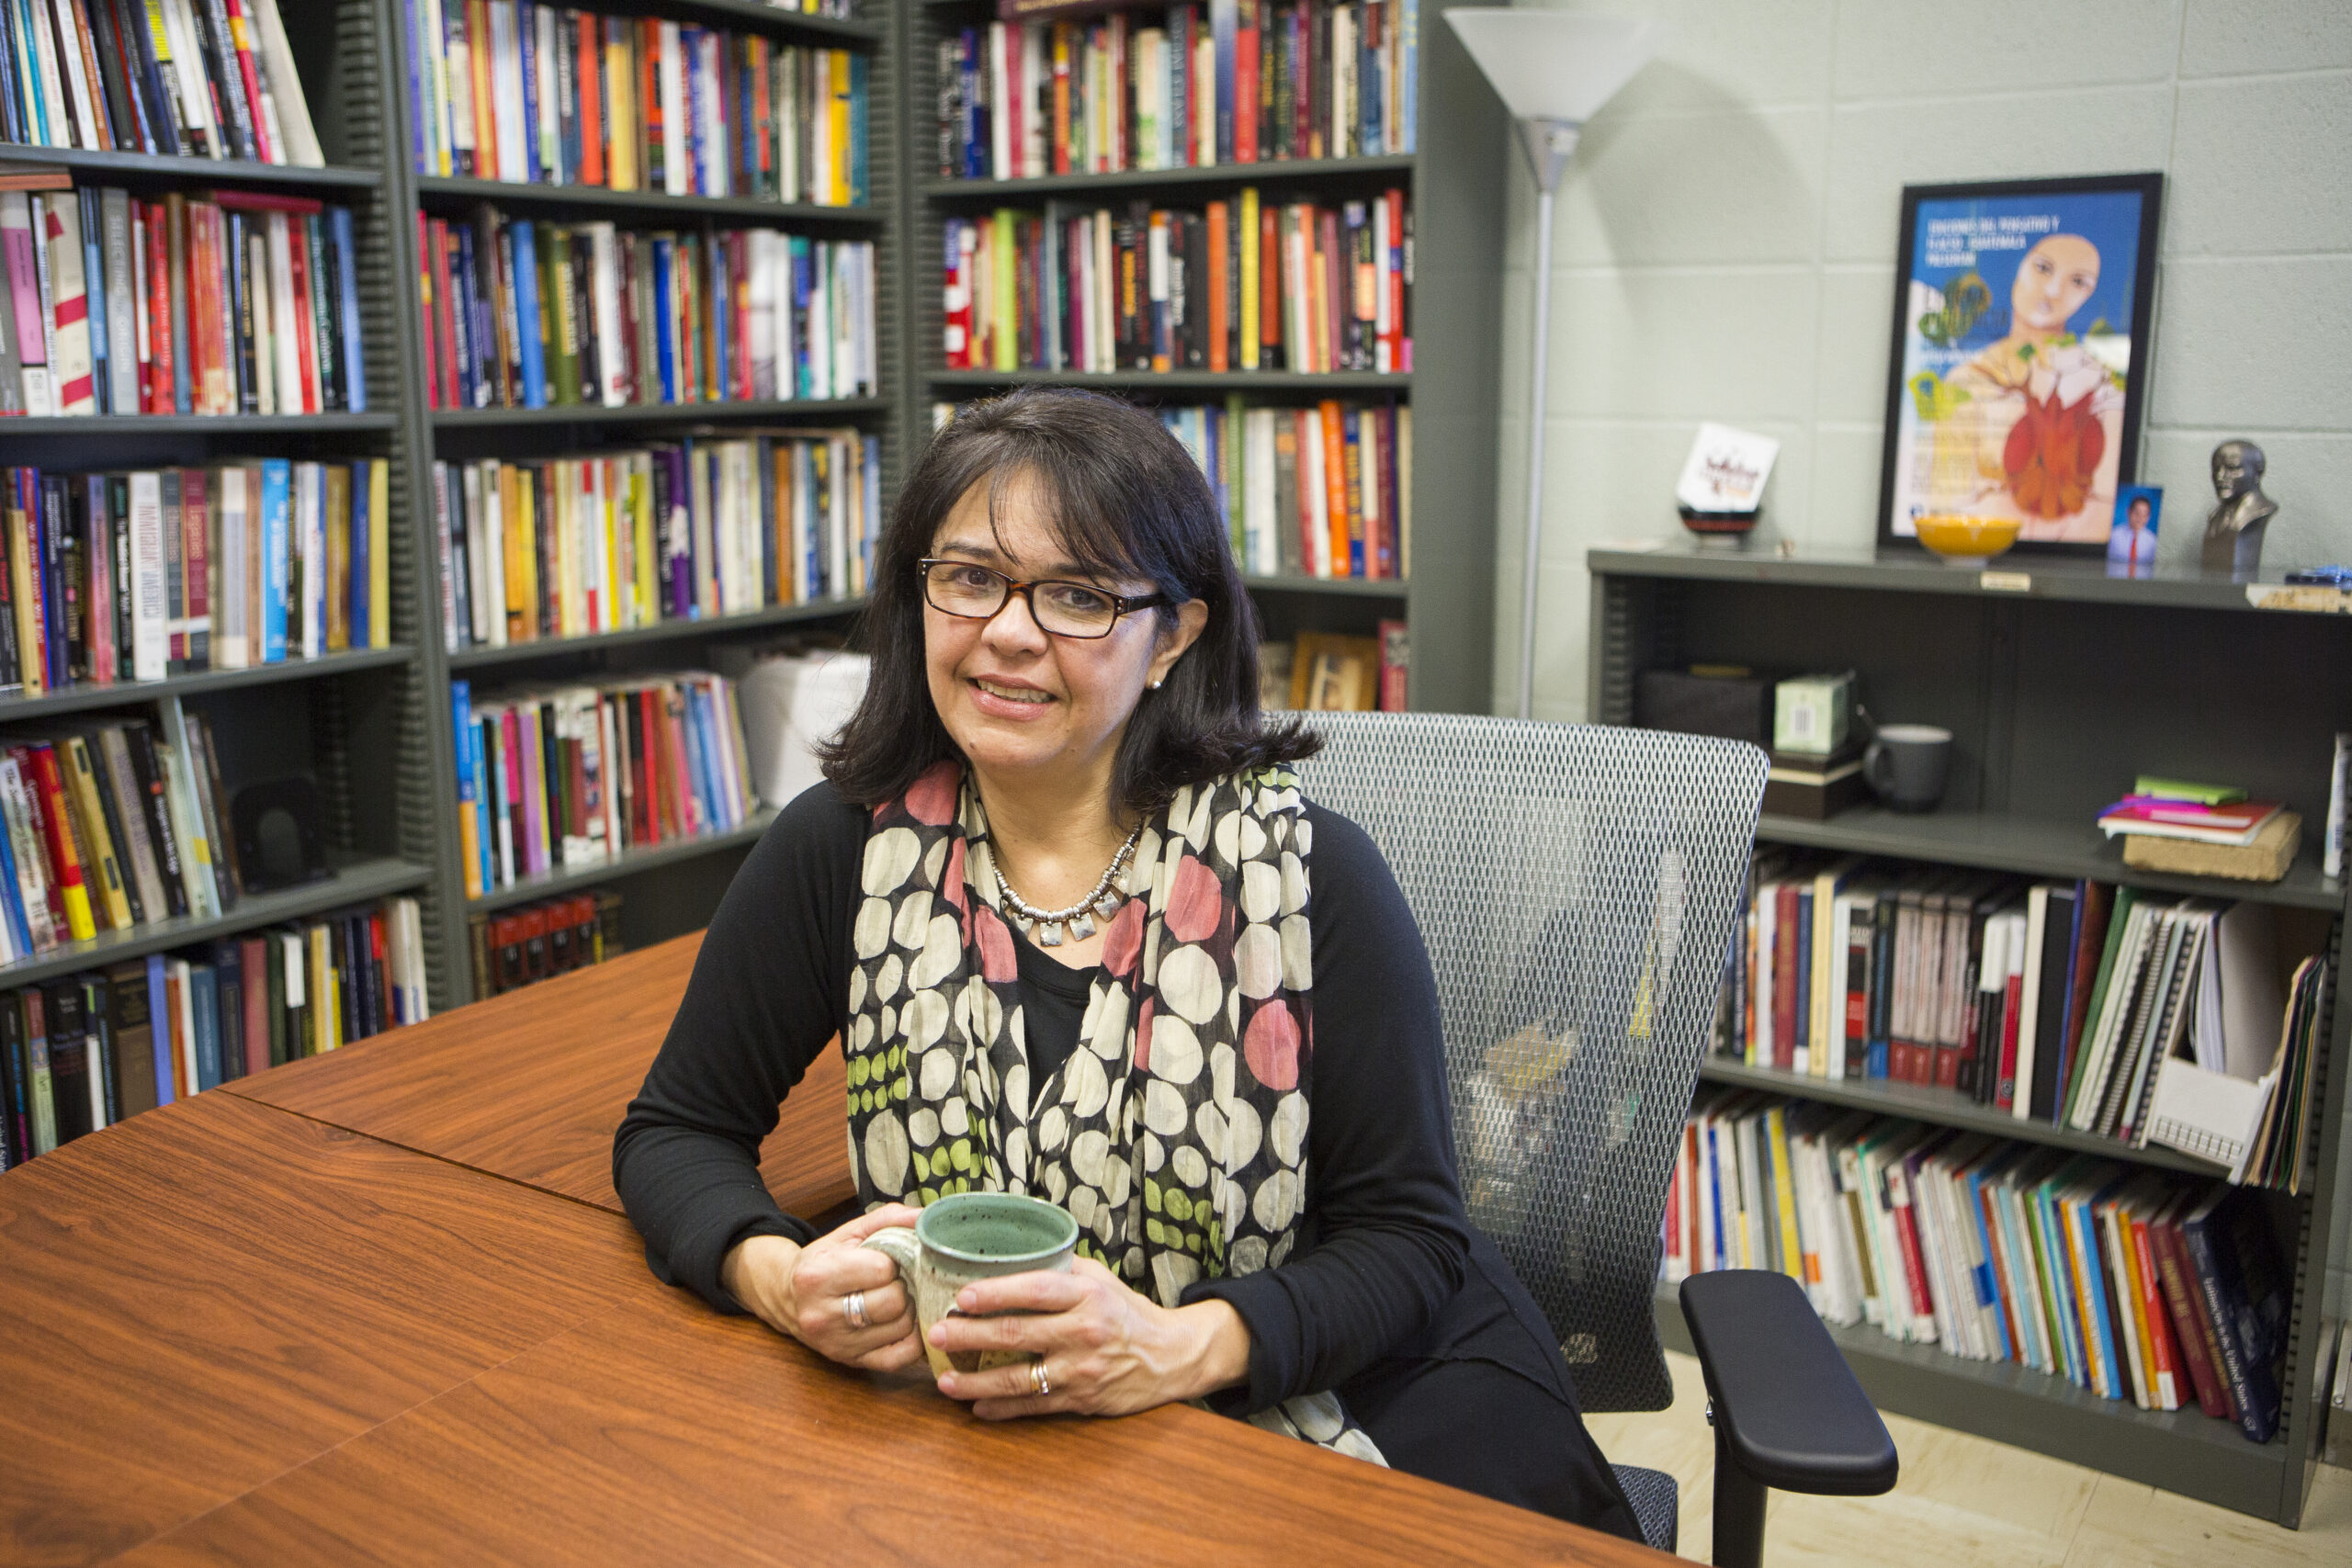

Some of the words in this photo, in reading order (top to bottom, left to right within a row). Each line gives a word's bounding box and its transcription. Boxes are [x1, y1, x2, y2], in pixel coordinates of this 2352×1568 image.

[2221, 1337, 2233, 1348] the
[2225, 1349, 2242, 1382] United
[2235, 1383, 2250, 1411] States
